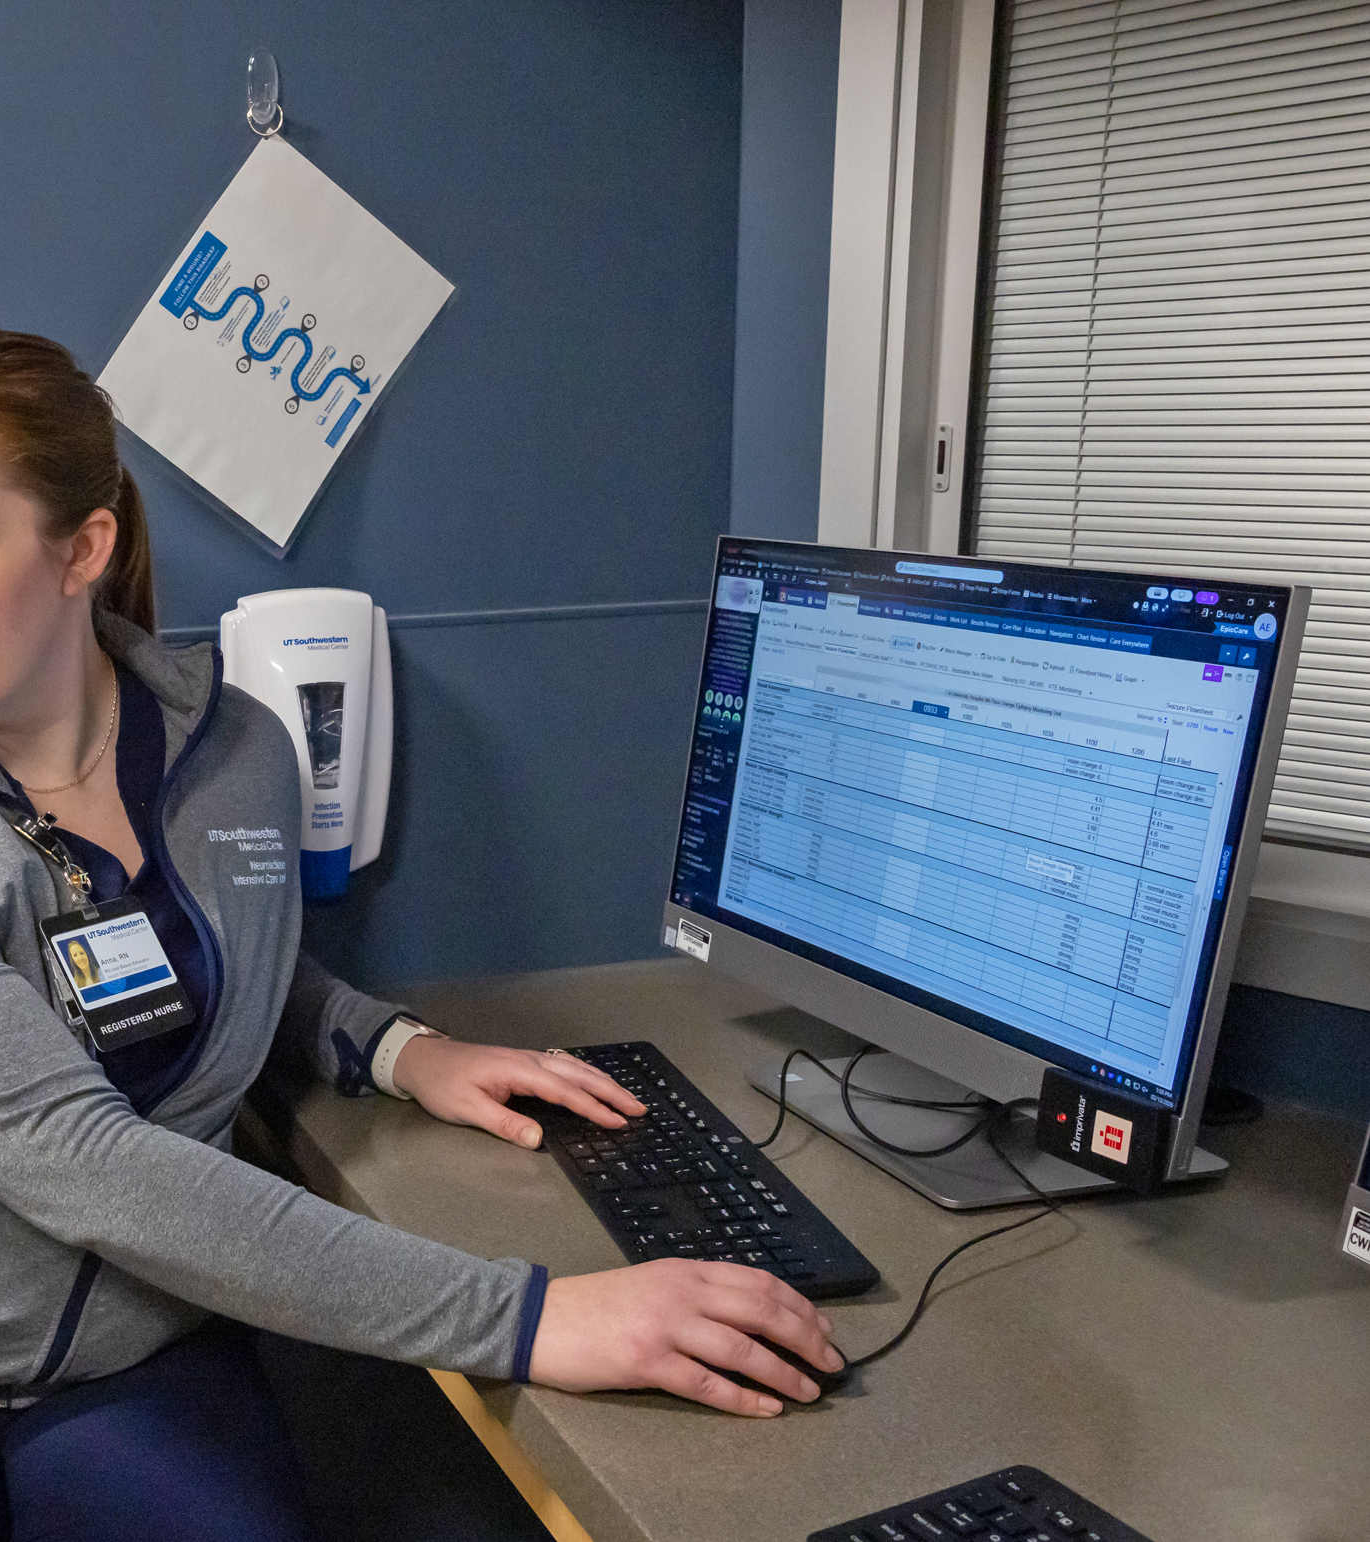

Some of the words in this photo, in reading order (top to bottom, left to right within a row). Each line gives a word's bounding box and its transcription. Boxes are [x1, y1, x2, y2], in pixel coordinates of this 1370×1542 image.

[173, 285, 190, 306] FOLLOW
[188, 271, 198, 285] THIS
[196, 245, 215, 270] ROADMAP
[174, 280, 184, 292] FIND
[186, 251, 203, 274] WOUND?
[762, 604, 788, 615] Flowsheets
[892, 608, 902, 616] MAR
[970, 618, 984, 627] Results
[984, 620, 999, 629] Review
[1001, 622, 1011, 630] Care
[1011, 624, 1022, 632] Plan
[1258, 621, 1271, 632] AE
[1024, 626, 1046, 635] Education
[1048, 629, 1073, 640] Navigators
[1219, 624, 1249, 636] EpicCare
[294, 637, 348, 645] Southwestern
[1076, 633, 1089, 641] Chart
[1089, 634, 1106, 643] Review
[1109, 637, 1121, 645] Care
[1121, 638, 1149, 650] Everywhere
[1001, 676, 1017, 685] Nursing
[1029, 680, 1044, 689] MEWS
[1122, 674, 1138, 684] Graph
[1047, 683, 1058, 691] VTE
[1058, 685, 1082, 696] Monitoring
[923, 704, 937, 714] 0933
[1031, 706, 1052, 716] Monitoring
[1165, 701, 1185, 712] Seizure
[1185, 705, 1214, 717] Flowsheet
[1000, 721, 1012, 729] 1025
[1202, 724, 1218, 733] Reset
[1222, 727, 1234, 736] Now
[1085, 738, 1098, 746] 1100
[1131, 747, 1145, 756] 1200
[1066, 757, 1080, 765] vision
[1079, 760, 1097, 771] change
[1163, 754, 1176, 763] Last
[1176, 756, 1192, 766] Filed
[1064, 767, 1078, 775] vision
[1078, 770, 1095, 780] change
[1159, 777, 1175, 785] vision
[1174, 780, 1195, 792] change
[1157, 787, 1173, 796] vision
[1172, 790, 1193, 802] change
[315, 802, 340, 810] Infection
[312, 811, 343, 819] Prevention
[1153, 809, 1162, 817] 4.5
[1151, 820, 1162, 828] 4.41
[1159, 843, 1169, 851] mm
[1145, 849, 1154, 857] 0.1
[1221, 851, 1230, 868] Open
[1217, 870, 1227, 887] Brain
[1050, 887, 1065, 895] normal
[1145, 883, 1165, 894] normal
[1166, 889, 1183, 900] muscle
[1143, 893, 1163, 905] normal
[1164, 899, 1181, 910] muscle
[1141, 903, 1161, 914] normal
[1162, 909, 1179, 920] muscle
[1065, 912, 1079, 923] strong
[1139, 913, 1159, 924] normal
[1160, 919, 1177, 930] muscle
[87, 930, 96, 939] UT
[97, 918, 146, 937] Southwestern
[1063, 922, 1078, 932] strong
[110, 930, 131, 941] Medical
[131, 925, 148, 935] Center
[1061, 931, 1076, 942] strong
[1129, 934, 1145, 944] strong
[1060, 941, 1074, 951] strong
[1127, 944, 1143, 954] strong
[119, 952, 129, 960] RN
[1058, 950, 1072, 960] strong
[1125, 953, 1140, 964] strong
[1056, 959, 1071, 970] strong
[1123, 963, 1139, 973] strong
[1121, 972, 1136, 983] strong
[1119, 982, 1134, 993] strong
[100, 1011, 153, 1035] REGISTERED
[153, 1001, 183, 1017] NURSE
[1075, 1096, 1086, 1141] imprivata
